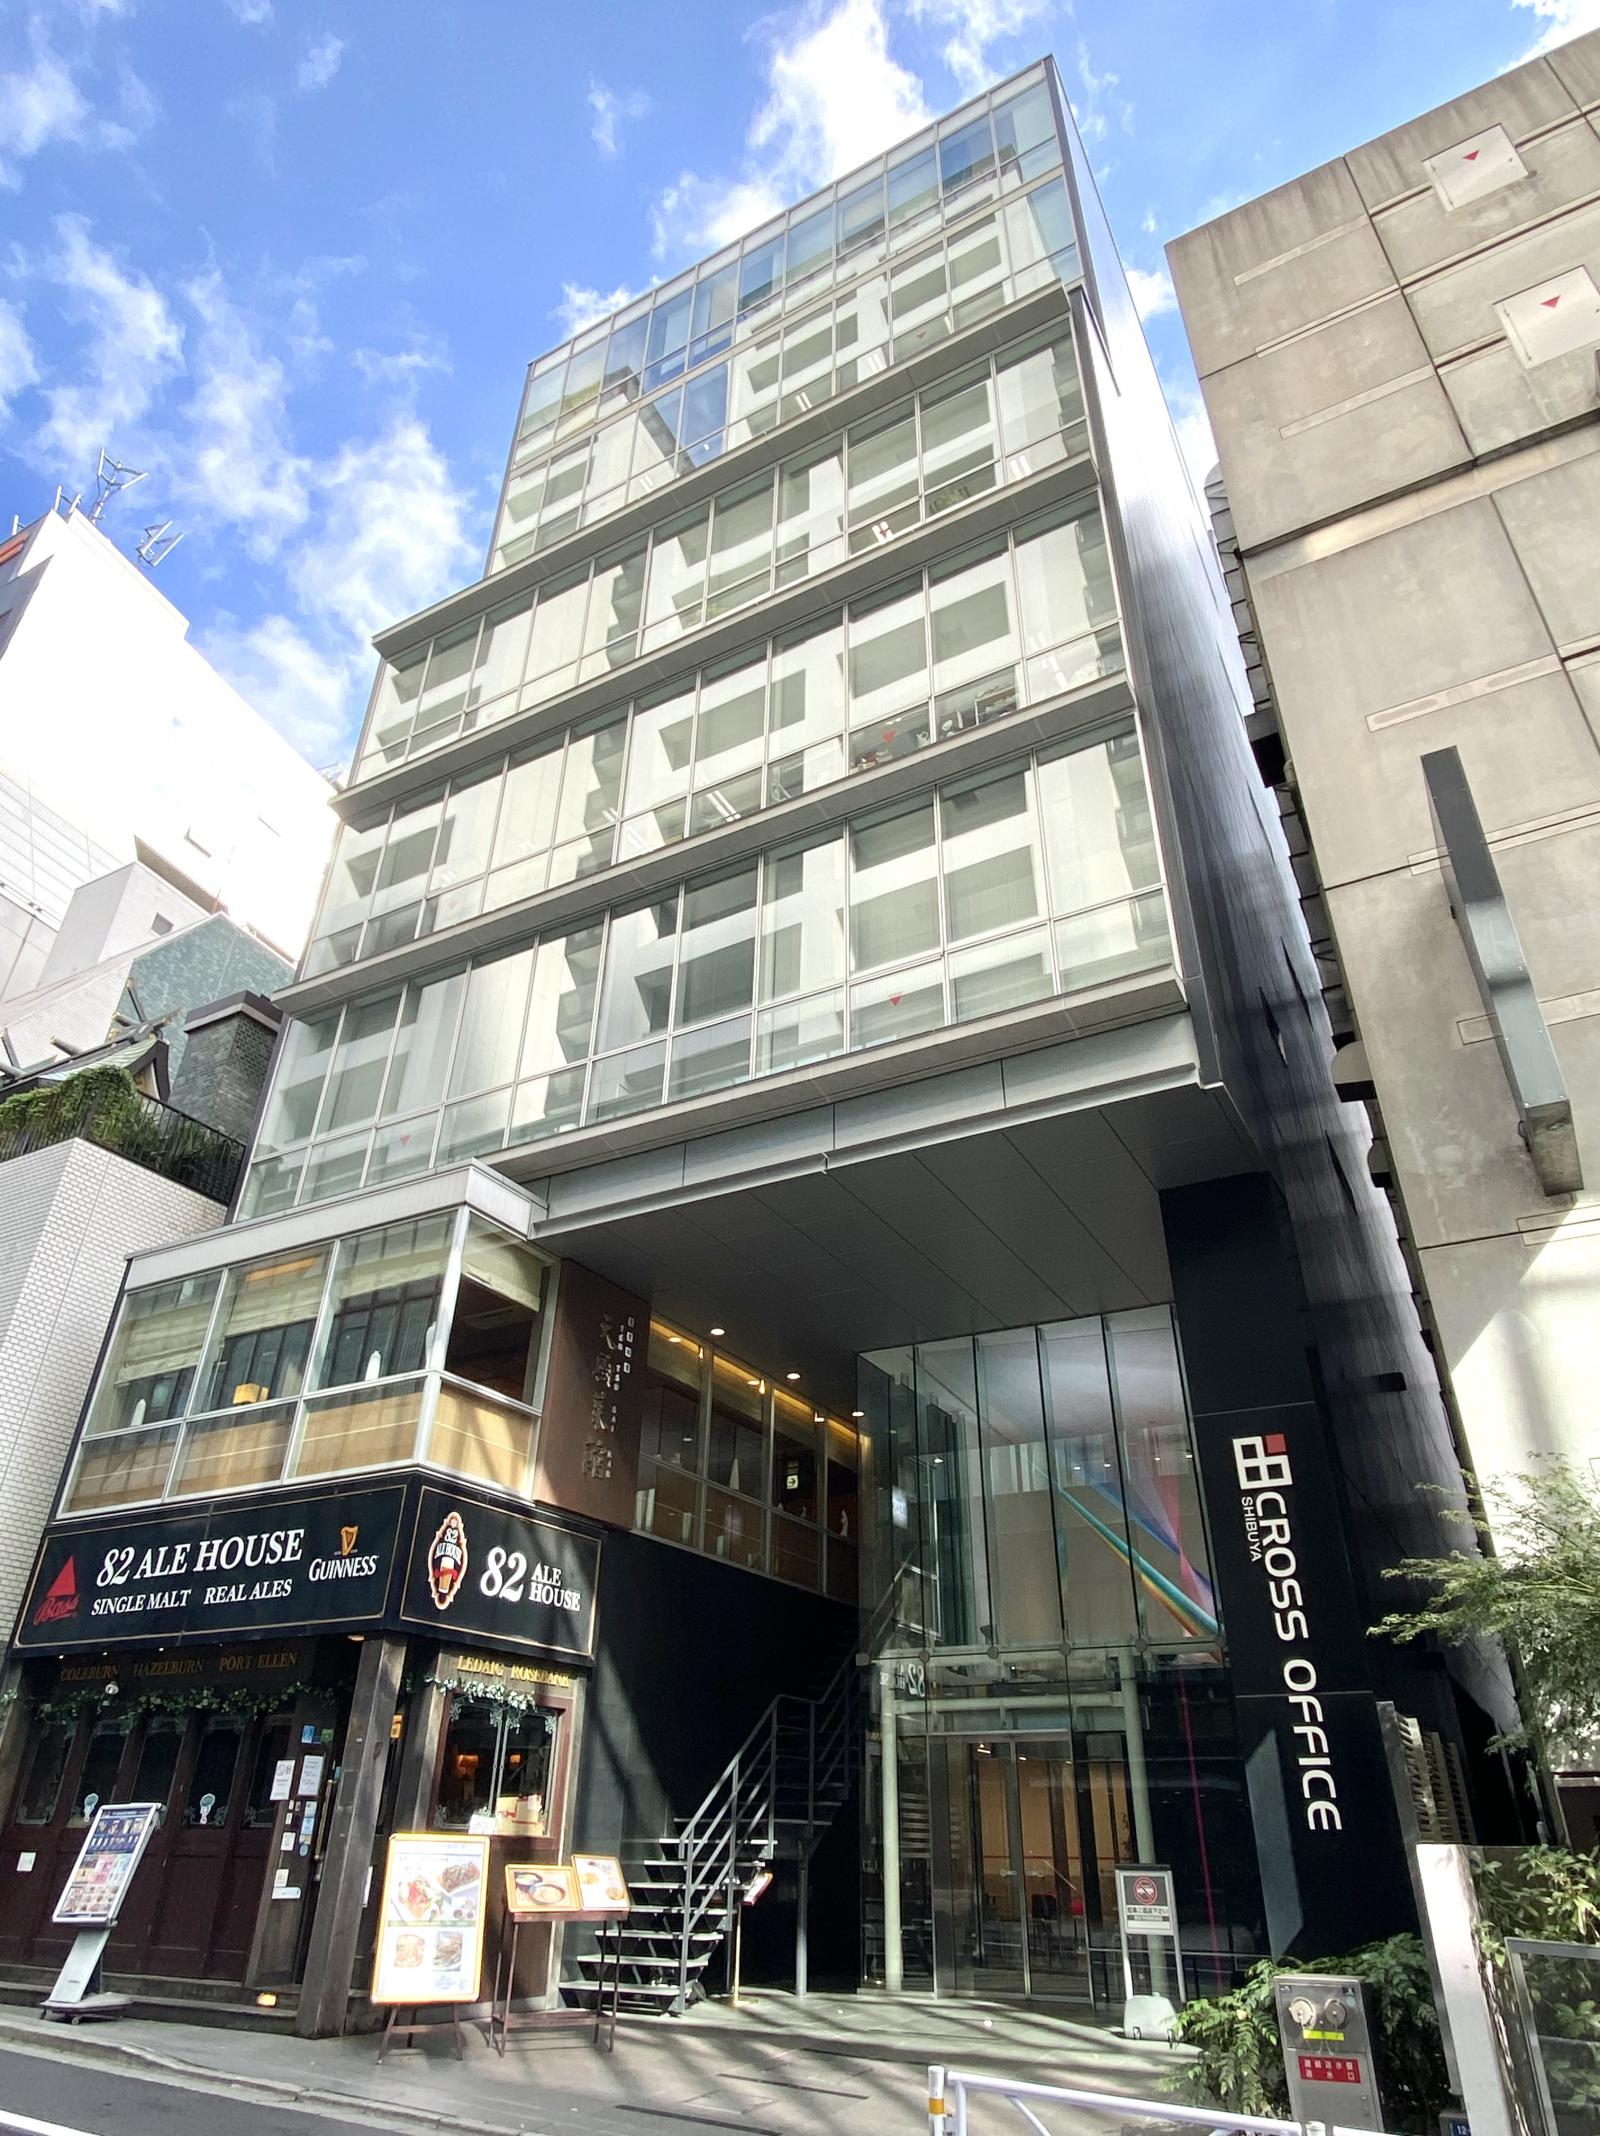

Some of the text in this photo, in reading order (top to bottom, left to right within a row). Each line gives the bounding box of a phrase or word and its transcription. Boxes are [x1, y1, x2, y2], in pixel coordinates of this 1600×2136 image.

[444, 1527, 459, 1544] 82
[1240, 1495, 1263, 1563] SHIBUYA
[96, 1528, 306, 1587] 82 ALE HOUSE
[308, 1555, 380, 1582] GUINNESS
[479, 1546, 529, 1603] 82
[530, 1561, 563, 1587] ALE
[91, 1578, 293, 1616] SINGLE MALT REAL ALES
[528, 1581, 582, 1612] HOUSE
[60, 1651, 298, 1682] COLEBURN HAZELBURN PORT ELLEN
[456, 1655, 504, 1676] LEDAIG
[1255, 1491, 1343, 1832] CROSS OFFICE
